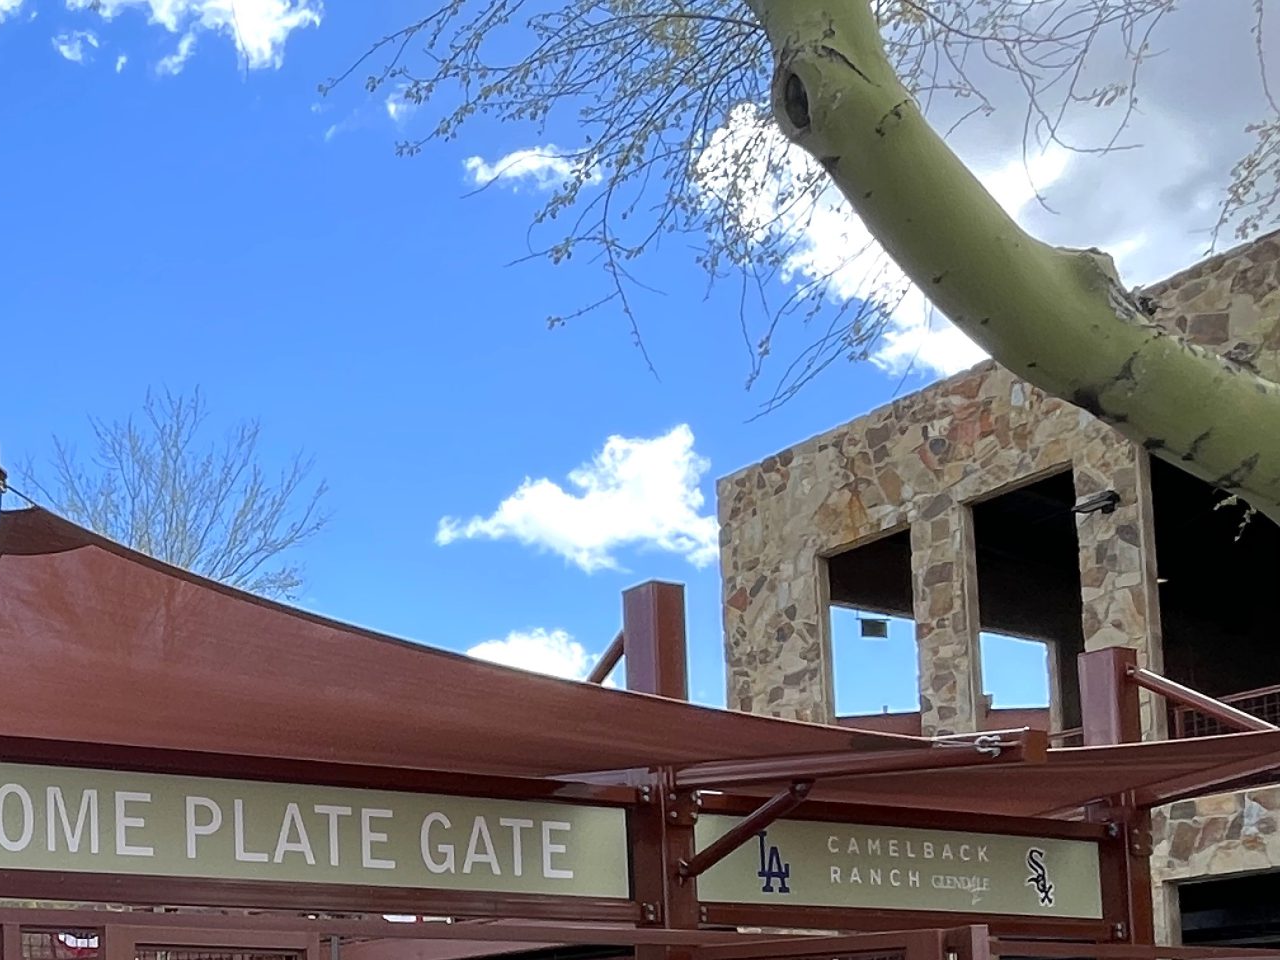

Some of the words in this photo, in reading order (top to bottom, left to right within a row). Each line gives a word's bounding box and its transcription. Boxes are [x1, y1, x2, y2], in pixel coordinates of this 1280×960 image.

[185, 795, 396, 869] PLATE
[420, 811, 573, 879] GATE
[827, 836, 990, 862] CAMELBACK
[757, 831, 790, 893] LA
[830, 866, 921, 888] RANCH
